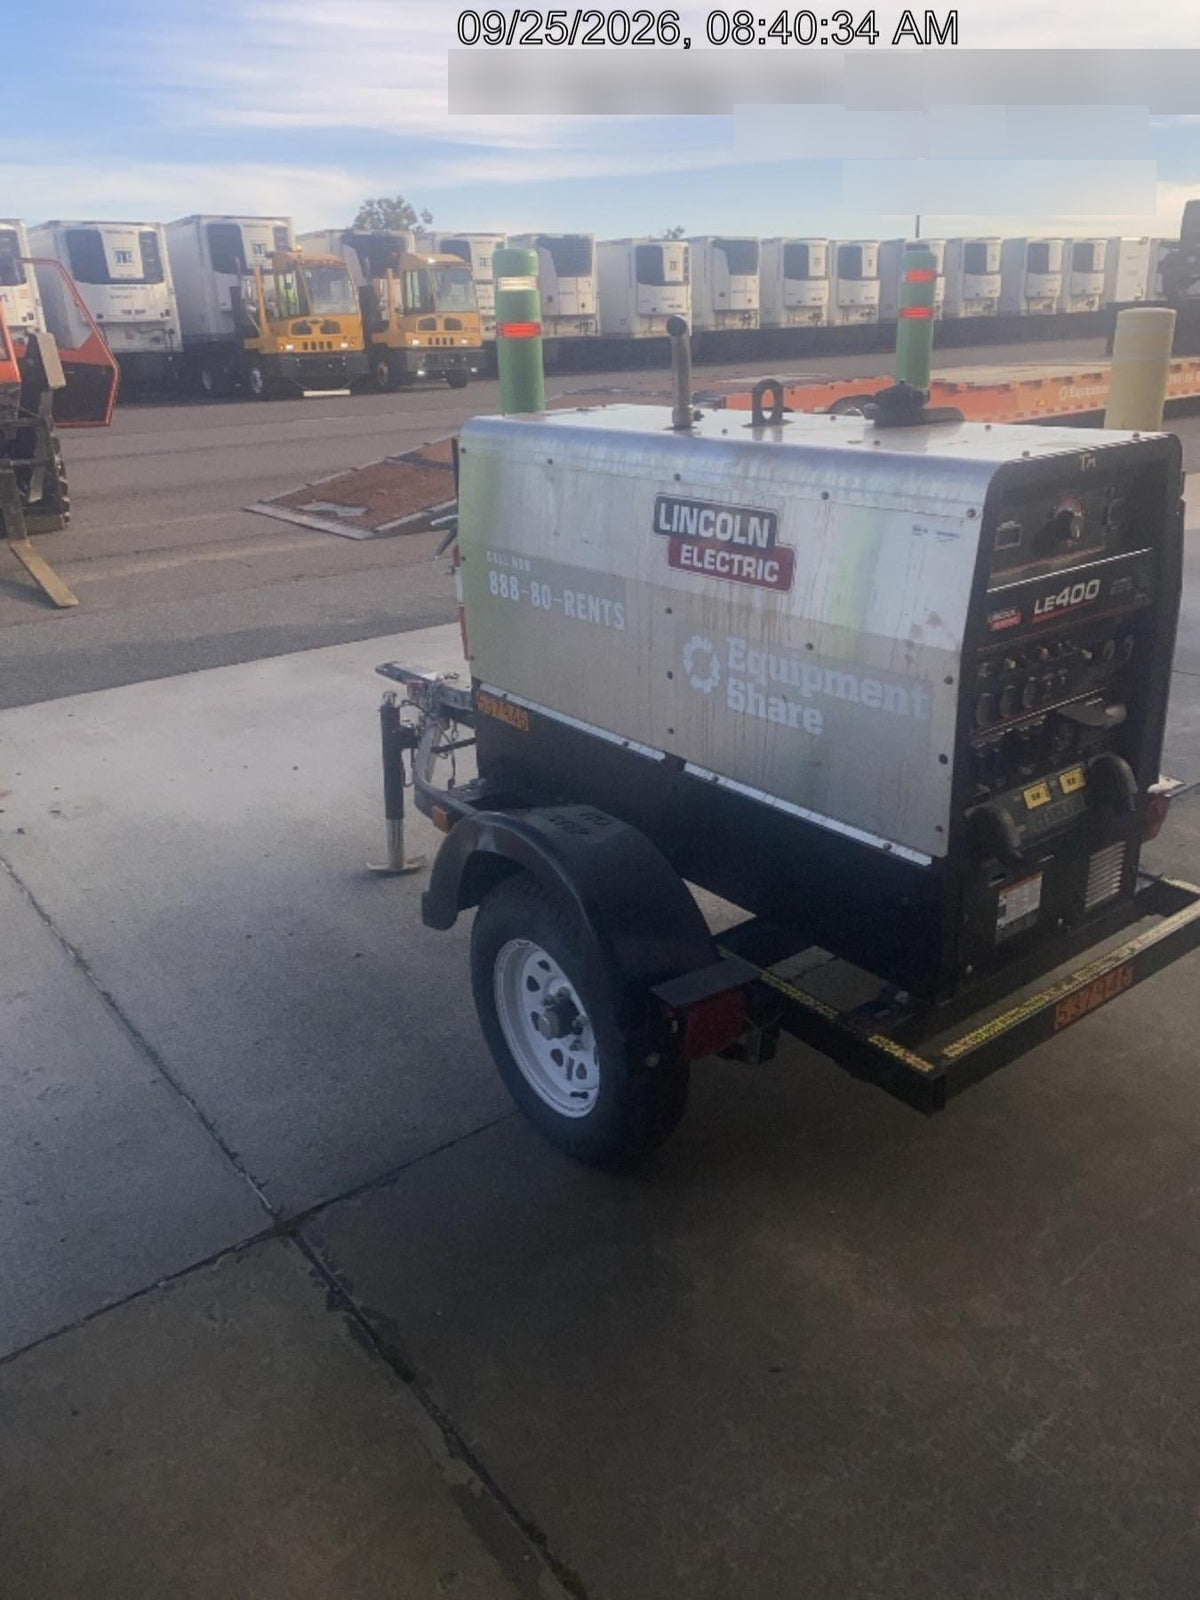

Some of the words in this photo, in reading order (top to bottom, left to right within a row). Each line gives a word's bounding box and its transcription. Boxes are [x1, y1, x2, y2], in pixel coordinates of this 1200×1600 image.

[658, 502, 771, 548] LINCOLN
[680, 544, 780, 583] ELECTRIC
[488, 570, 625, 630] 888-80-RENTS
[1034, 578, 1101, 615] LE400
[726, 637, 929, 721] Equipment
[727, 676, 824, 736] Share
